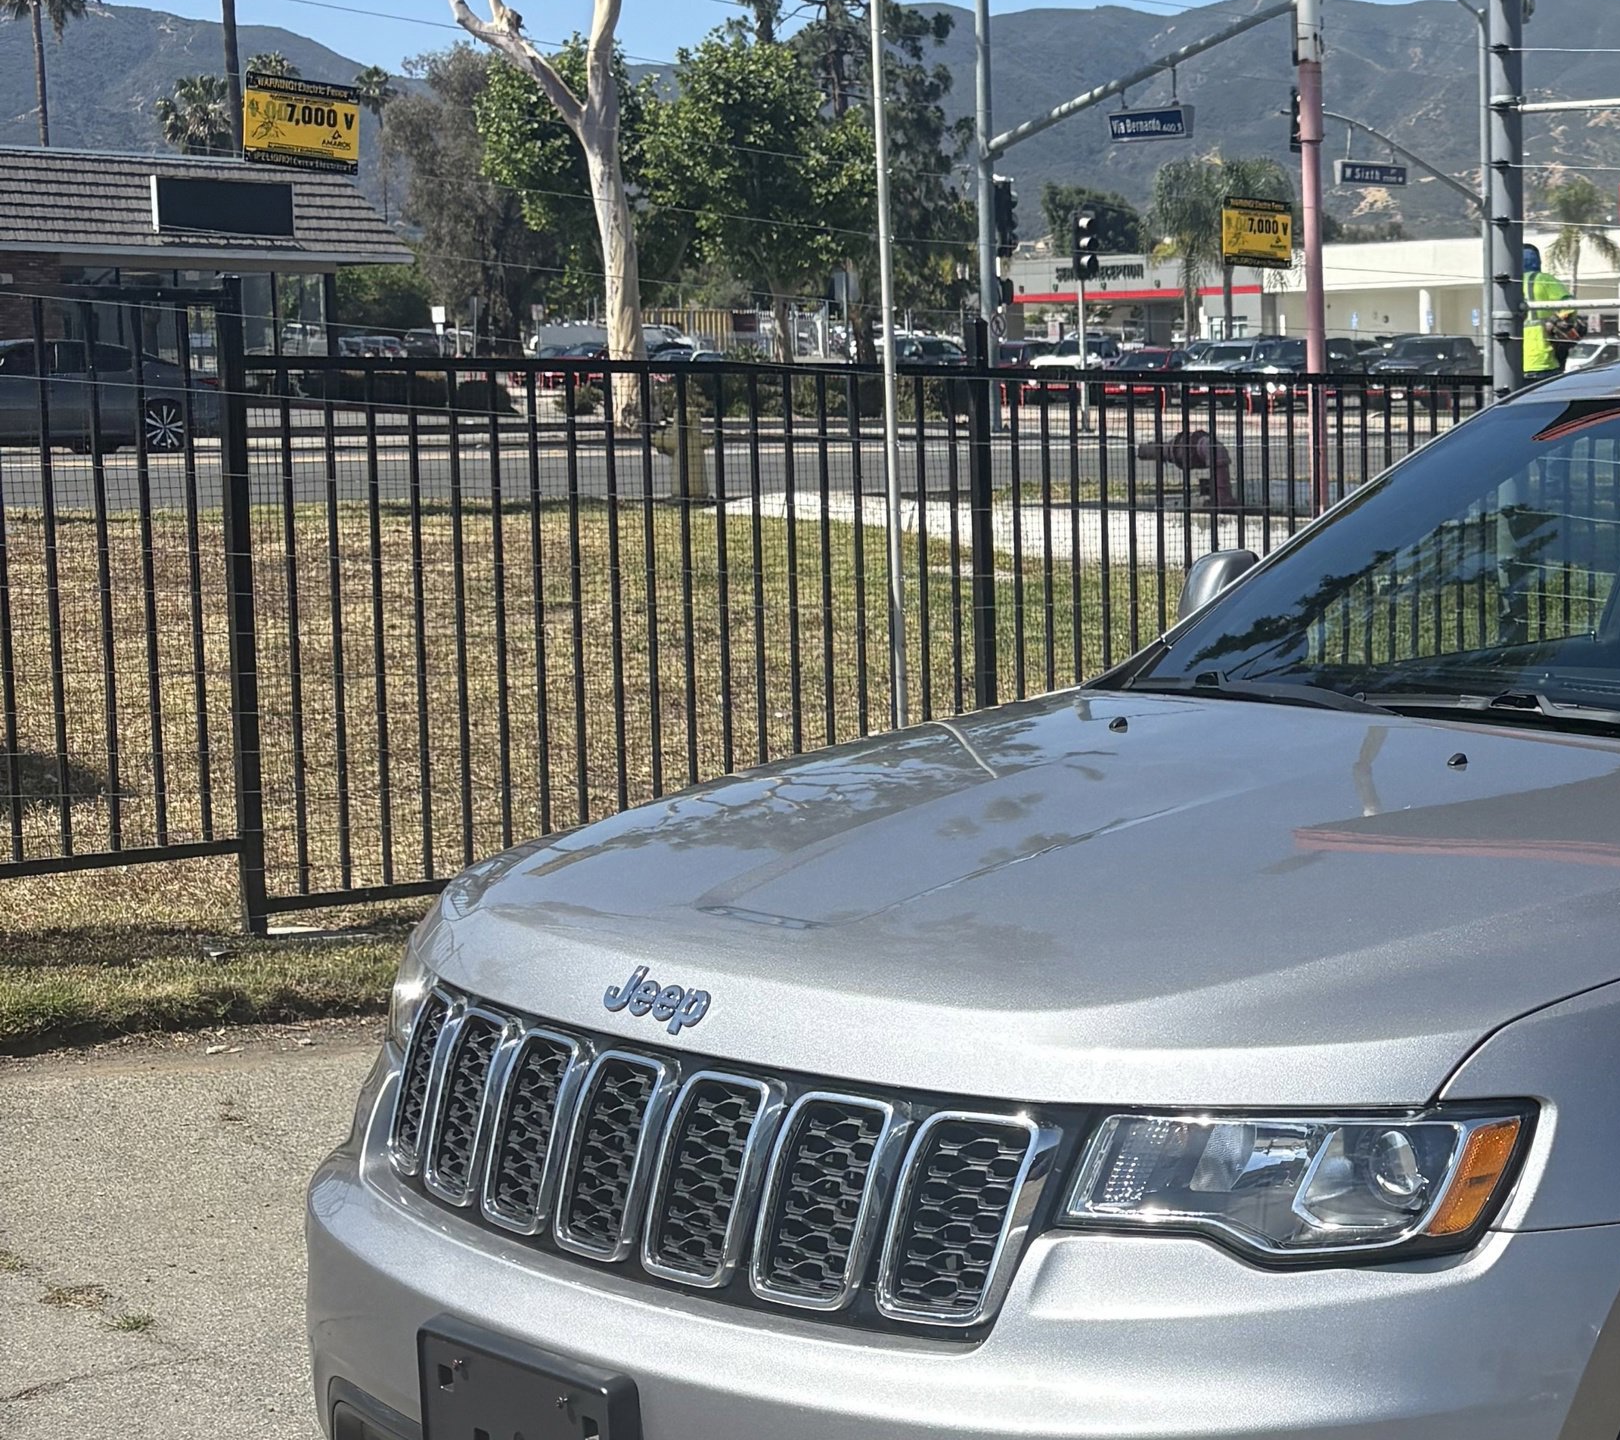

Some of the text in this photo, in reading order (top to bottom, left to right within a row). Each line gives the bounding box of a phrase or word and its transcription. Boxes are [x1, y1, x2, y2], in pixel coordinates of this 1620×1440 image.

[286, 103, 355, 130] 7,000 V
[1111, 120, 1125, 134] Via
[1126, 117, 1161, 133] Bernardo
[1354, 167, 1380, 180] Sixth
[1248, 217, 1288, 236] 7,000 V
[603, 965, 711, 1035] Jeep
